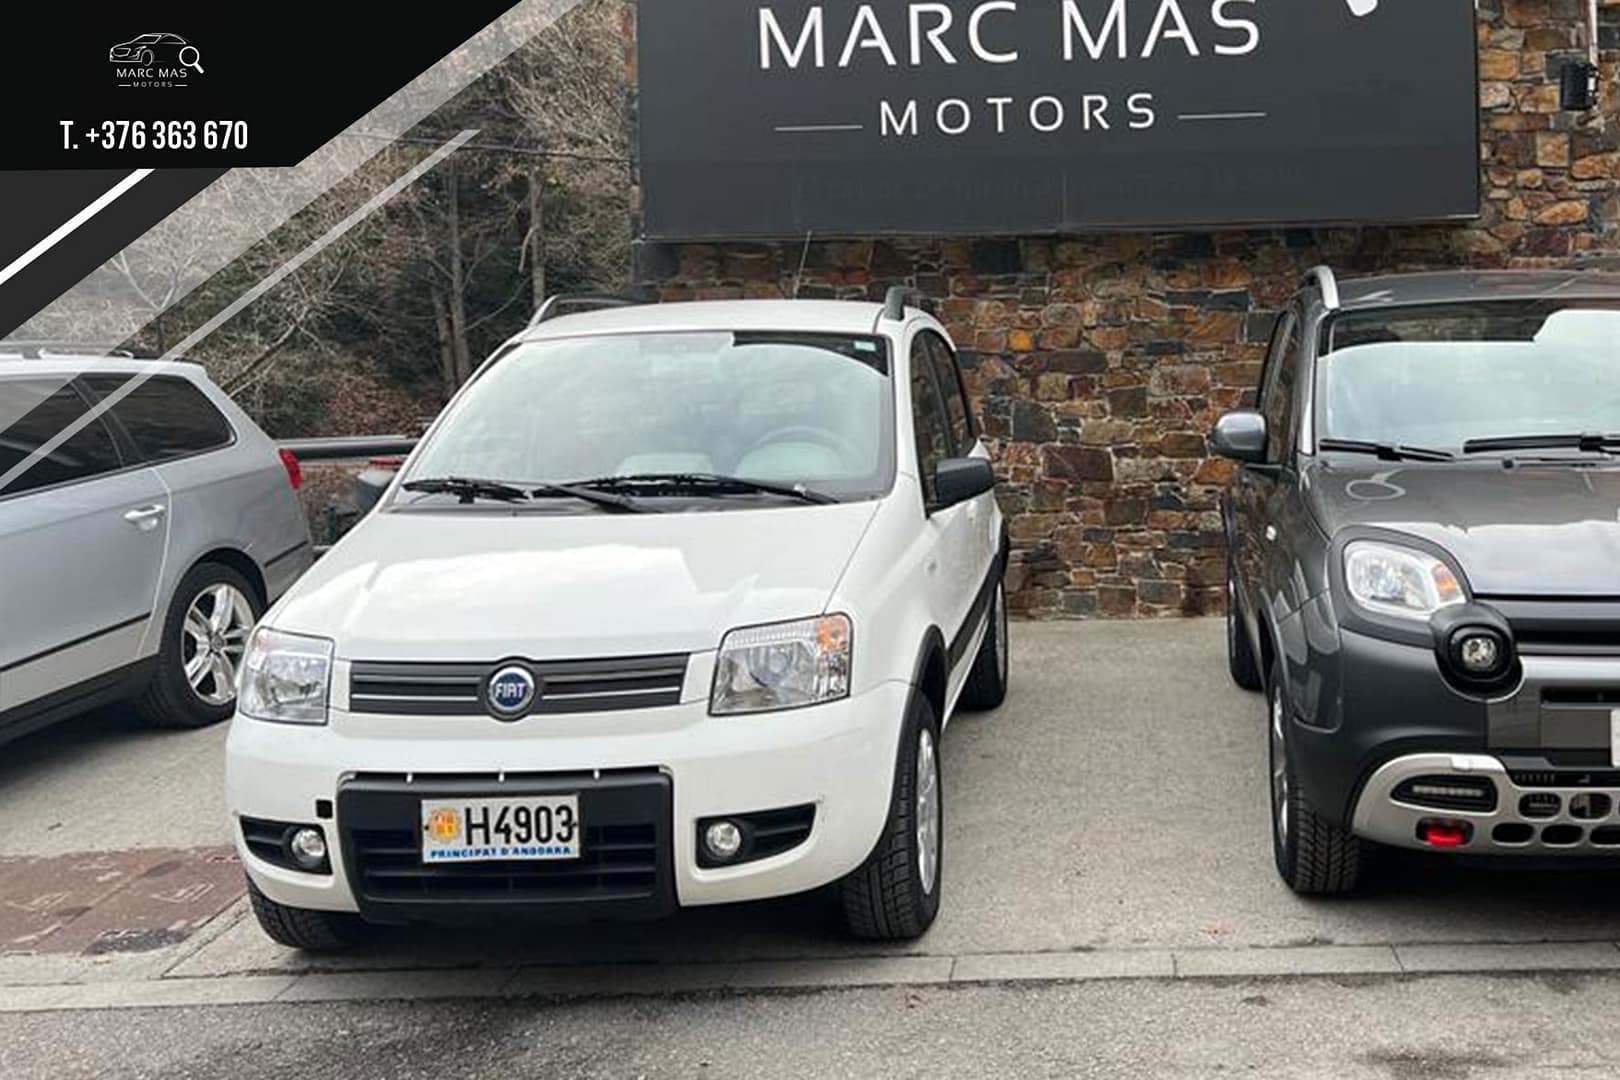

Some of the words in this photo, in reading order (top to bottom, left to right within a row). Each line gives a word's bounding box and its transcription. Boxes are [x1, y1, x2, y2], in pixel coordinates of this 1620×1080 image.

[760, 2, 1018, 69] MARC
[1062, 0, 1260, 61] MAS
[880, 92, 1155, 136] MOTORS
[495, 682, 527, 698] FIAT
[465, 805, 575, 845] H4903
[430, 848, 497, 858] PRINCIPAT
